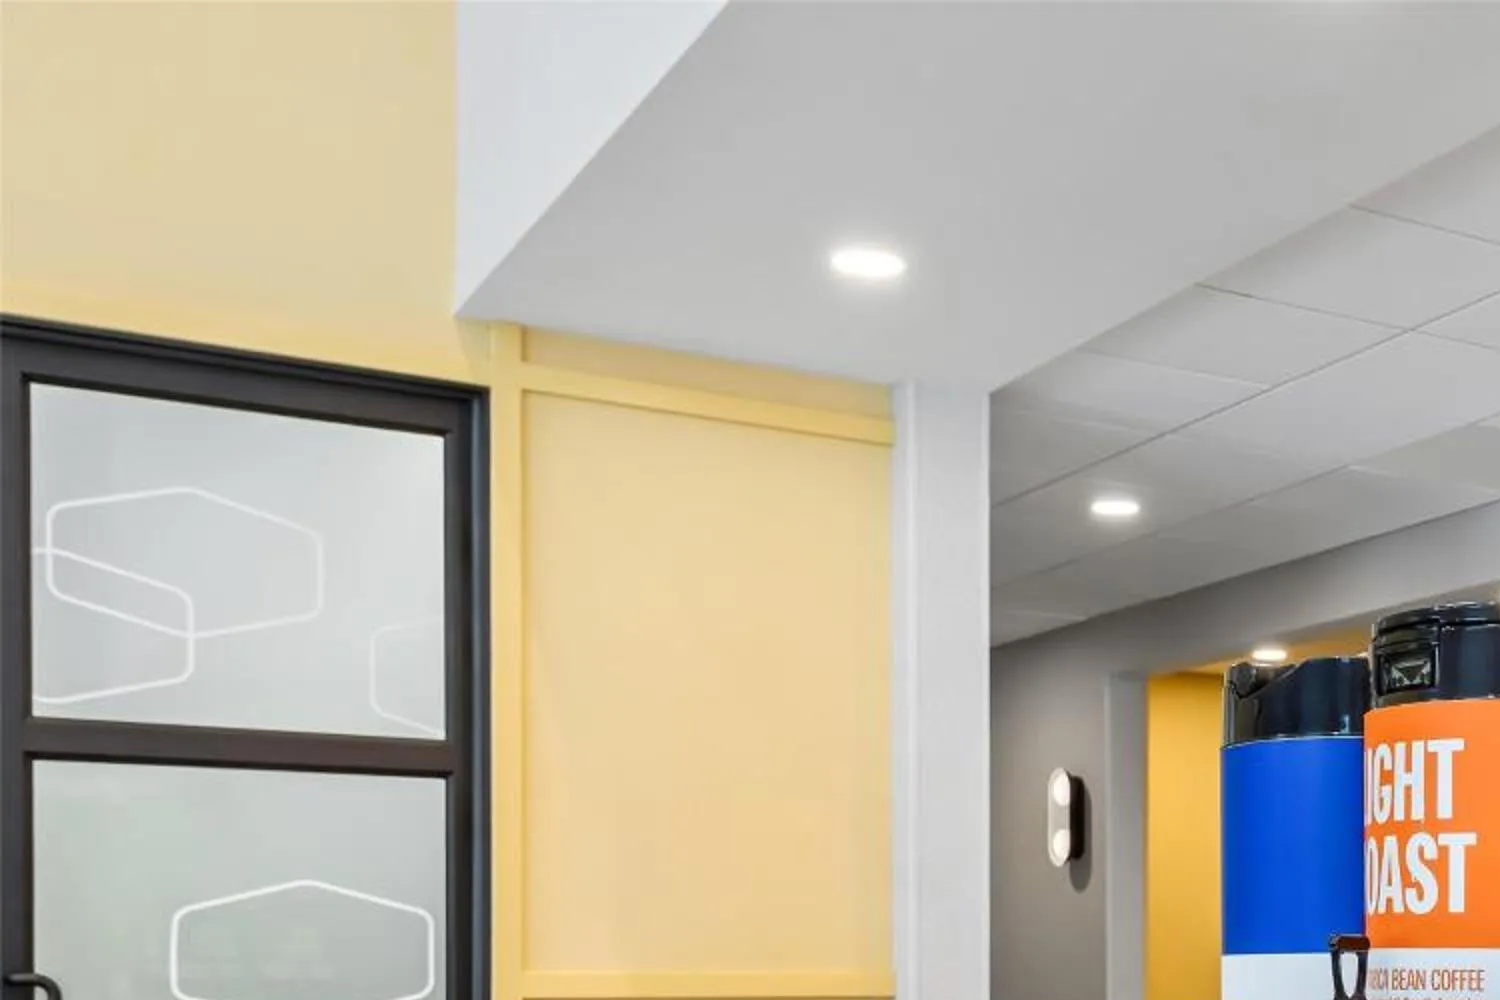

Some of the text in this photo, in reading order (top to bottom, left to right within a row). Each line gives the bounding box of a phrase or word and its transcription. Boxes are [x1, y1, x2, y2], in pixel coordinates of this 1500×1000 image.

[1364, 739, 1465, 825] IGHT
[1364, 832, 1477, 915] OAST
[1391, 968, 1427, 990] BEAN
[1431, 968, 1485, 991] COFFEE
